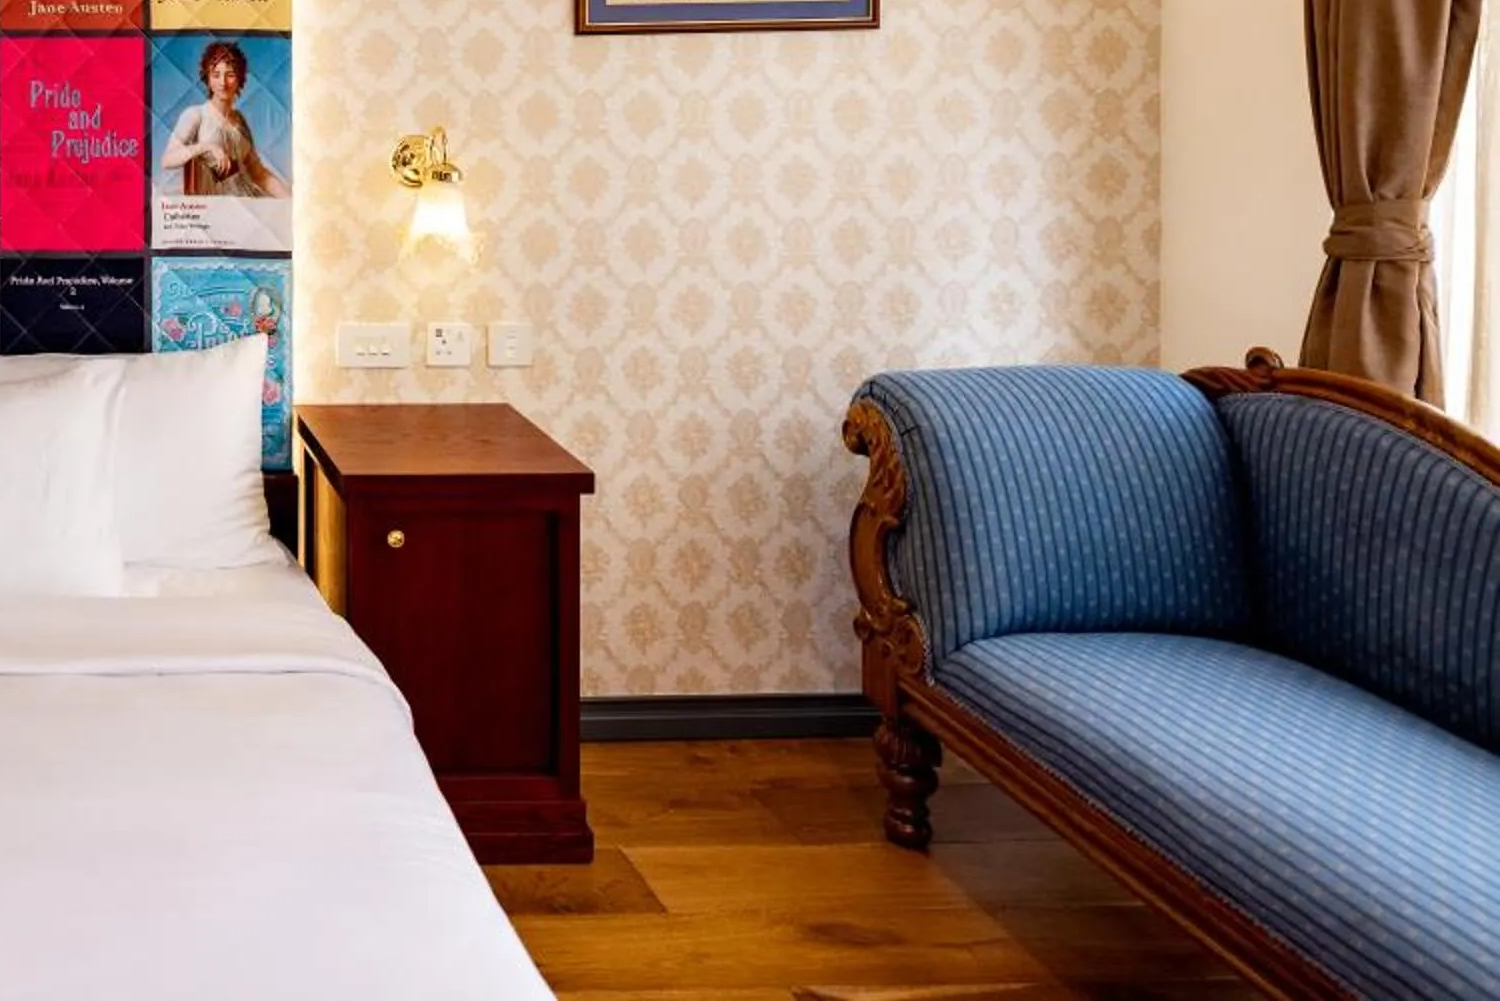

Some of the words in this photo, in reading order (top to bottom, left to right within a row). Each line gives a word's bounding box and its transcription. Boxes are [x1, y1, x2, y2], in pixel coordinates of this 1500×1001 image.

[28, 0, 65, 16] Jane
[69, 0, 123, 14] Austen
[29, 80, 81, 109] Pride
[67, 103, 102, 131] and
[52, 130, 138, 164] Prejudice
[10, 276, 35, 286] Pride
